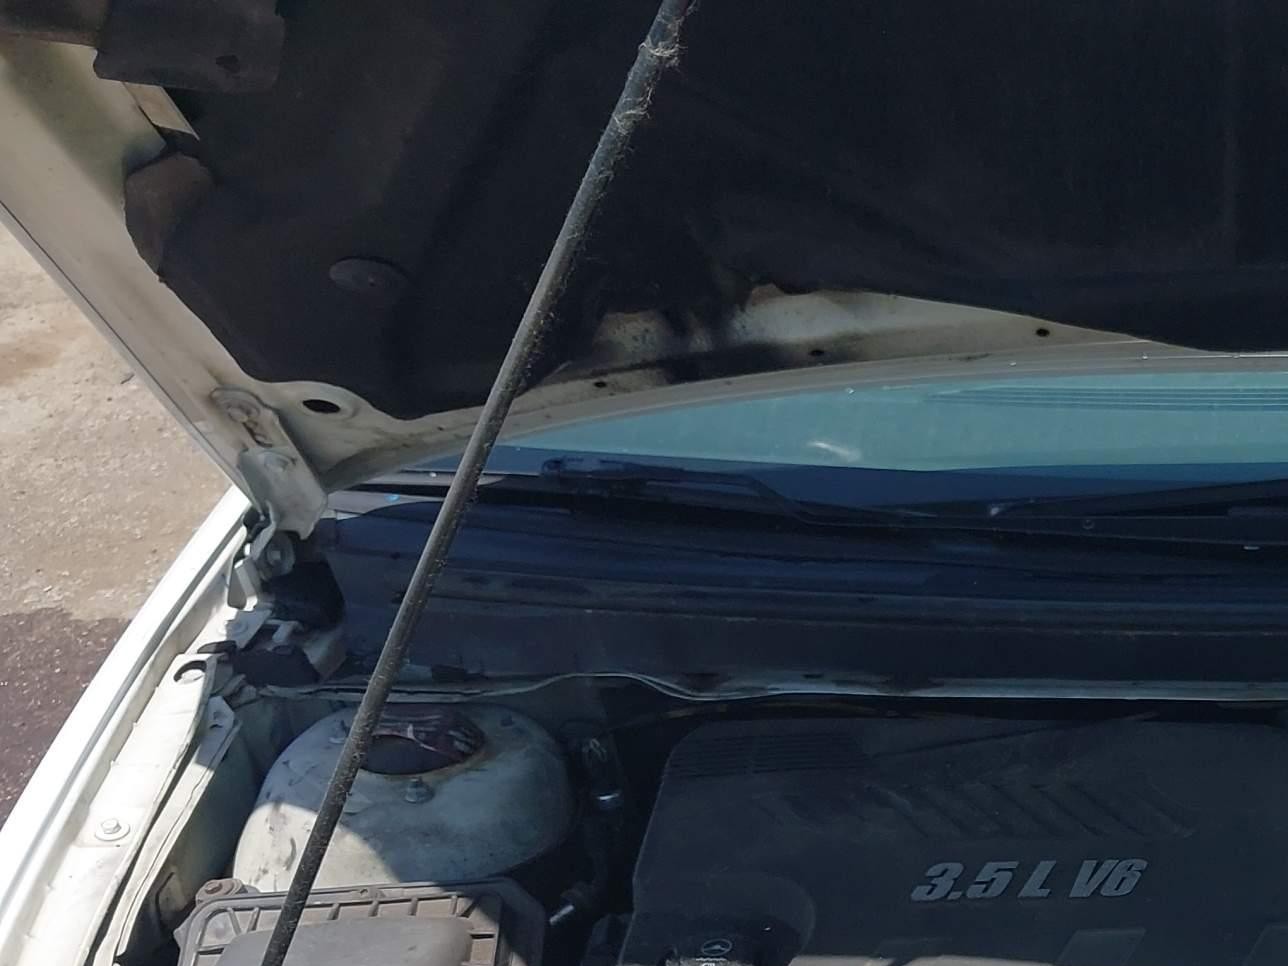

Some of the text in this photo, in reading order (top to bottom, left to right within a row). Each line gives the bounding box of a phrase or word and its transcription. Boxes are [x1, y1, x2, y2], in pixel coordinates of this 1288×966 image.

[910, 857, 1149, 902] 3.5 L V6
